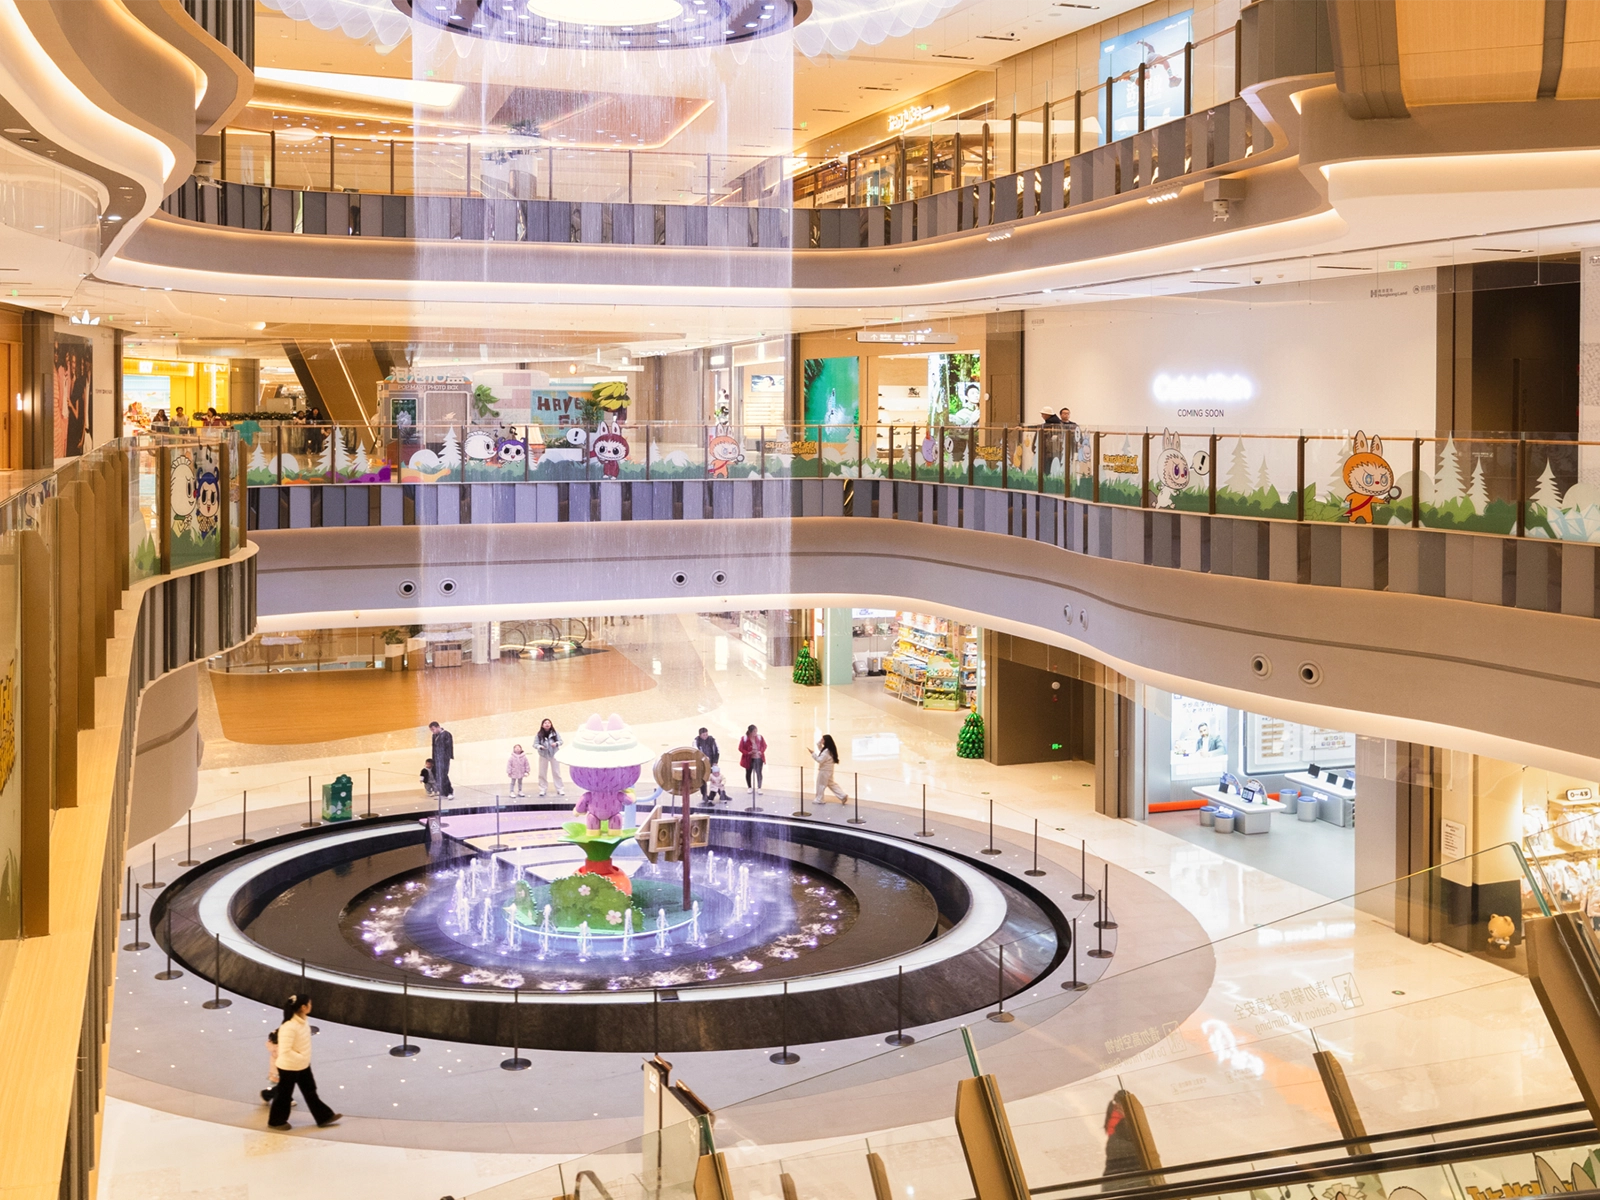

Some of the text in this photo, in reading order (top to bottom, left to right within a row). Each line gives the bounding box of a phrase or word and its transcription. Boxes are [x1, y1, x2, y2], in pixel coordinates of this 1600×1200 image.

[537, 396, 583, 413] HAVE
[1177, 409, 1224, 417] COMING SOON
